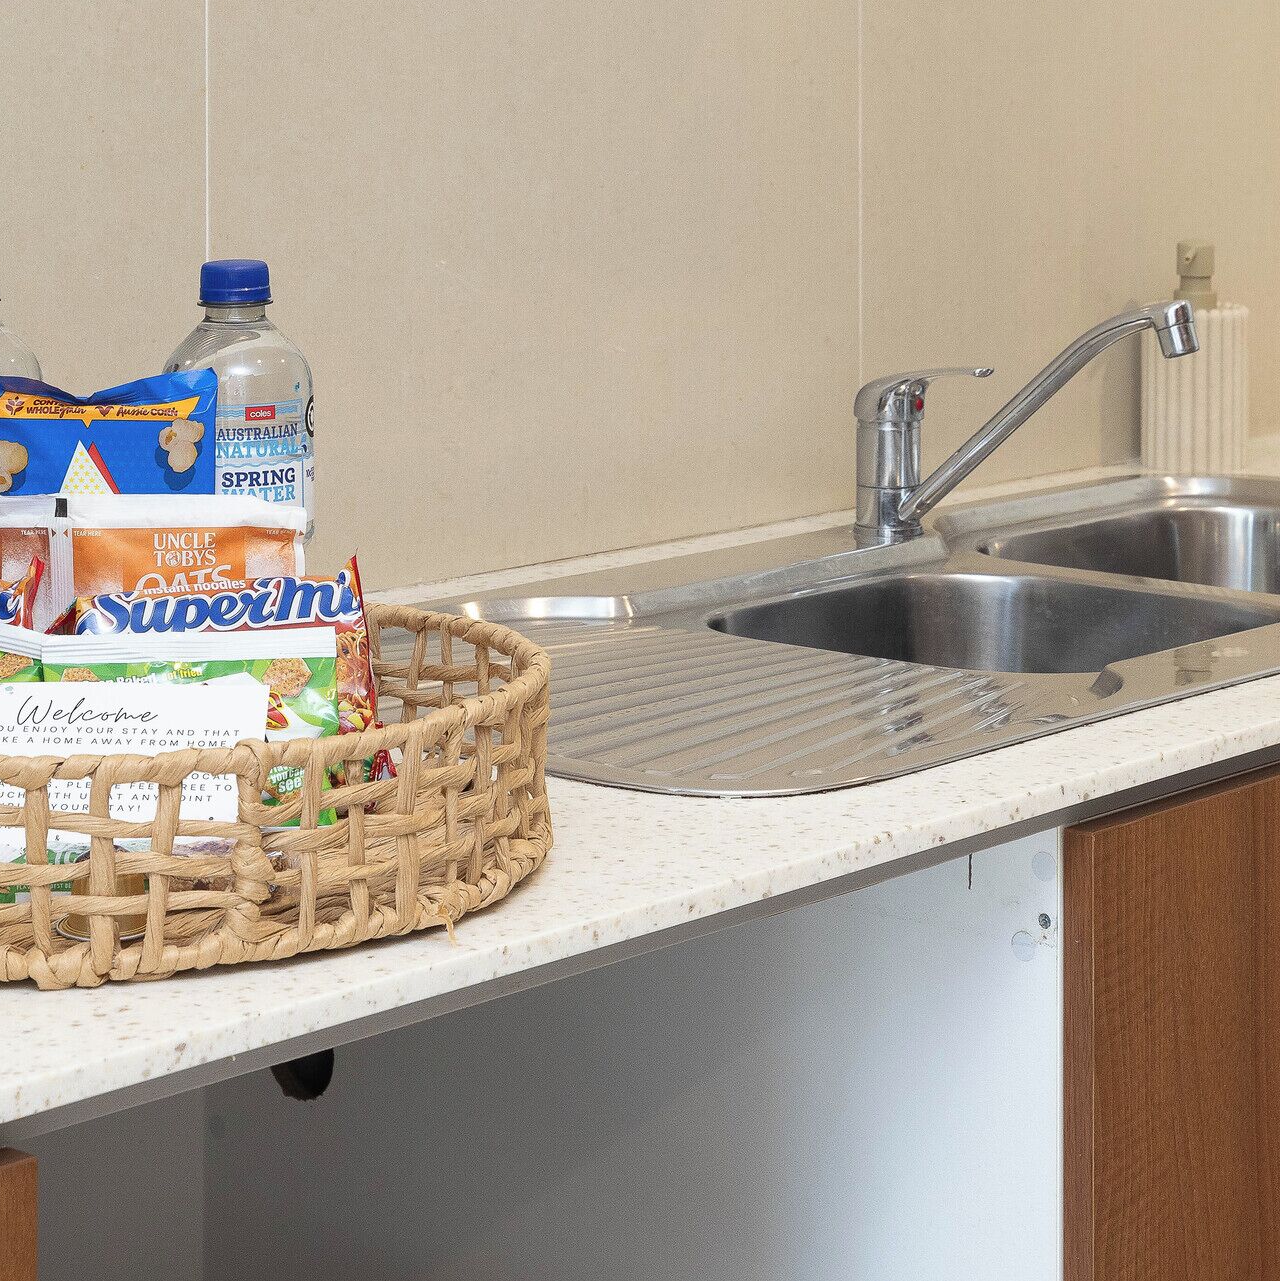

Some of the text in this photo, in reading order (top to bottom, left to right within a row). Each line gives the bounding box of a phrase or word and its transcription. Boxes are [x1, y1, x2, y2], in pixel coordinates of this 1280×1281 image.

[116, 407, 150, 417] Aussie
[249, 410, 272, 418] coles
[217, 423, 299, 441] AUSTRALIAN
[217, 437, 300, 459] NATURAL
[222, 467, 296, 488] SPRING
[153, 532, 216, 550] UNCLE
[154, 549, 217, 568] TOBYS
[192, 579, 247, 592] noodles
[16, 695, 158, 726] Welcome
[22, 725, 68, 734] ENJOY
[76, 726, 114, 735] YOUR
[121, 727, 159, 736] STAY
[166, 729, 195, 737] AND
[203, 729, 241, 737] THAT
[26, 737, 35, 745] A
[42, 737, 83, 745] HOME
[90, 738, 133, 746] AWAY
[140, 739, 180, 747] FROM
[187, 740, 234, 748] HOME.
[190, 772, 231, 781] OCAL
[129, 782, 160, 790] FEE
[181, 784, 207, 792] REE
[279, 777, 302, 793] see
[181, 795, 213, 803] OINT
[51, 803, 141, 813] YOUR TAY!
